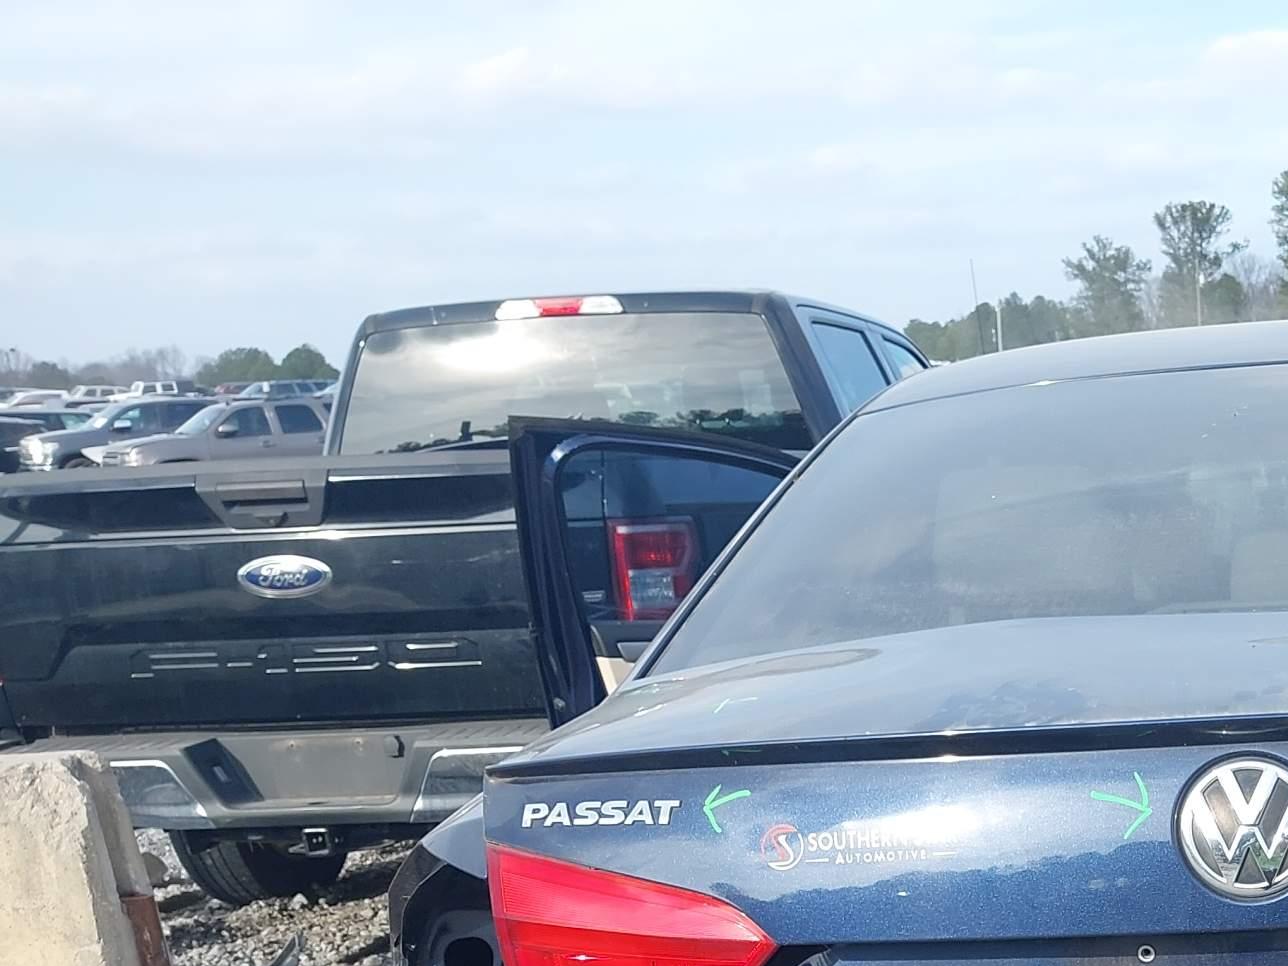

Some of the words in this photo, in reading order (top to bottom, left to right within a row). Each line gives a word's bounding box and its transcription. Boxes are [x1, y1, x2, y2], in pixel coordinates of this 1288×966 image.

[258, 563, 309, 587] Ford
[521, 799, 681, 828] PASSAT
[835, 849, 927, 865] AUTOMOTIVE
